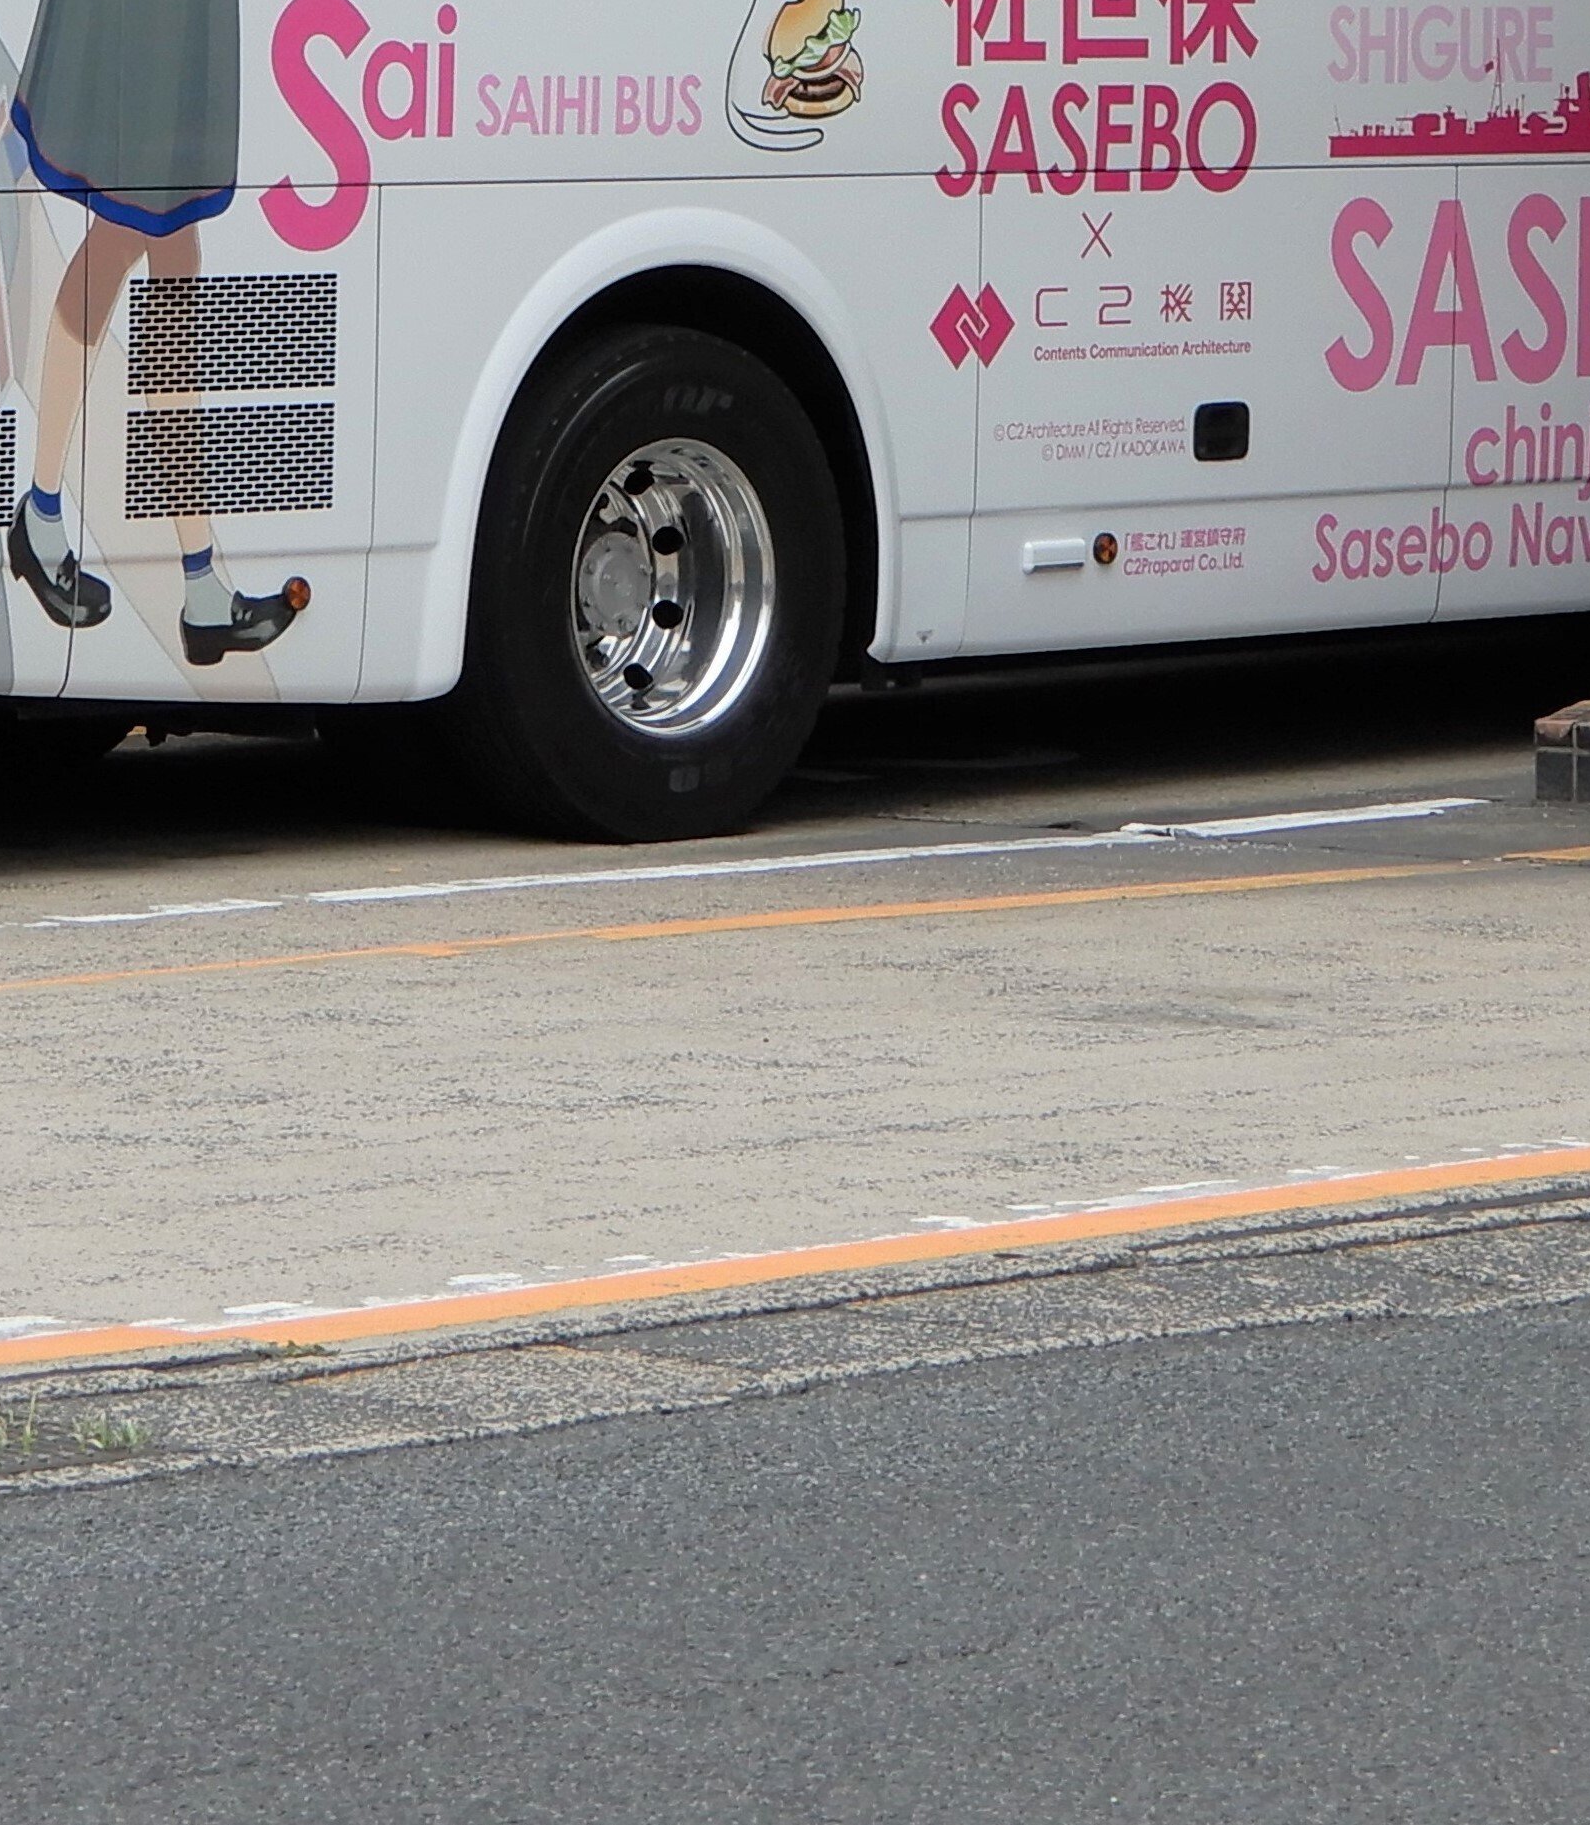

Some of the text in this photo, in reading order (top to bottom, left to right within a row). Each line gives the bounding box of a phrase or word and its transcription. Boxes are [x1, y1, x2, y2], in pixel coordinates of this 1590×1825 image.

[1328, 5, 1553, 84] SHIGURE
[476, 74, 601, 136] SAIHI
[615, 74, 703, 136] BUS
[934, 81, 1258, 198] SASEBO
[1033, 339, 1252, 361] Contents Communication Architecture
[1312, 506, 1494, 583] Sasebo
